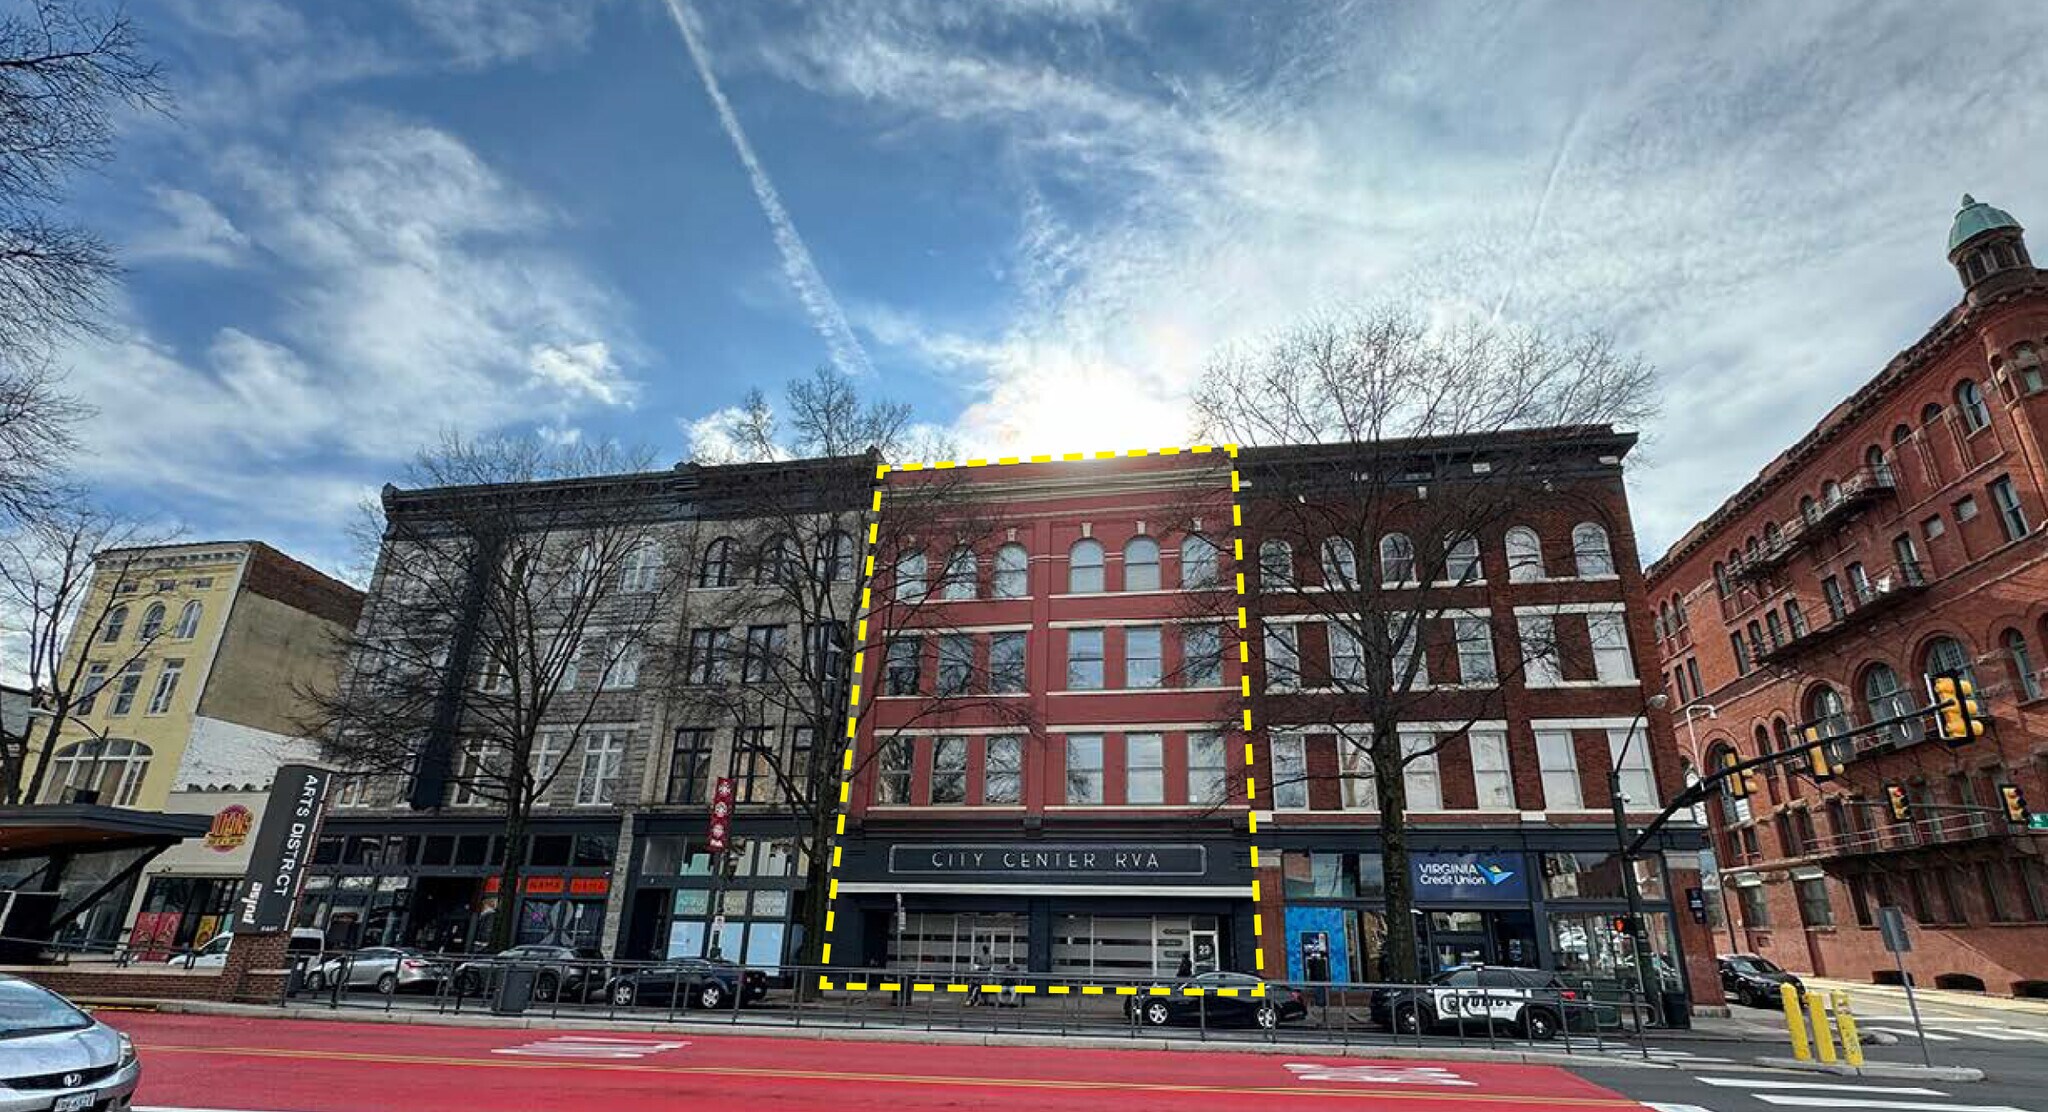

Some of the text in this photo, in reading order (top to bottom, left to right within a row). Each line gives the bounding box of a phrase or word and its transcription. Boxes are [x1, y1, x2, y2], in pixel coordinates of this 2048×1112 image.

[274, 774, 318, 897] ARTS DISTRICT
[932, 852, 1160, 869] CITY CENTER RVA
[1419, 863, 1478, 875] VIRGINIA
[1420, 873, 1486, 885] Credit Union
[241, 881, 263, 925] pulse
